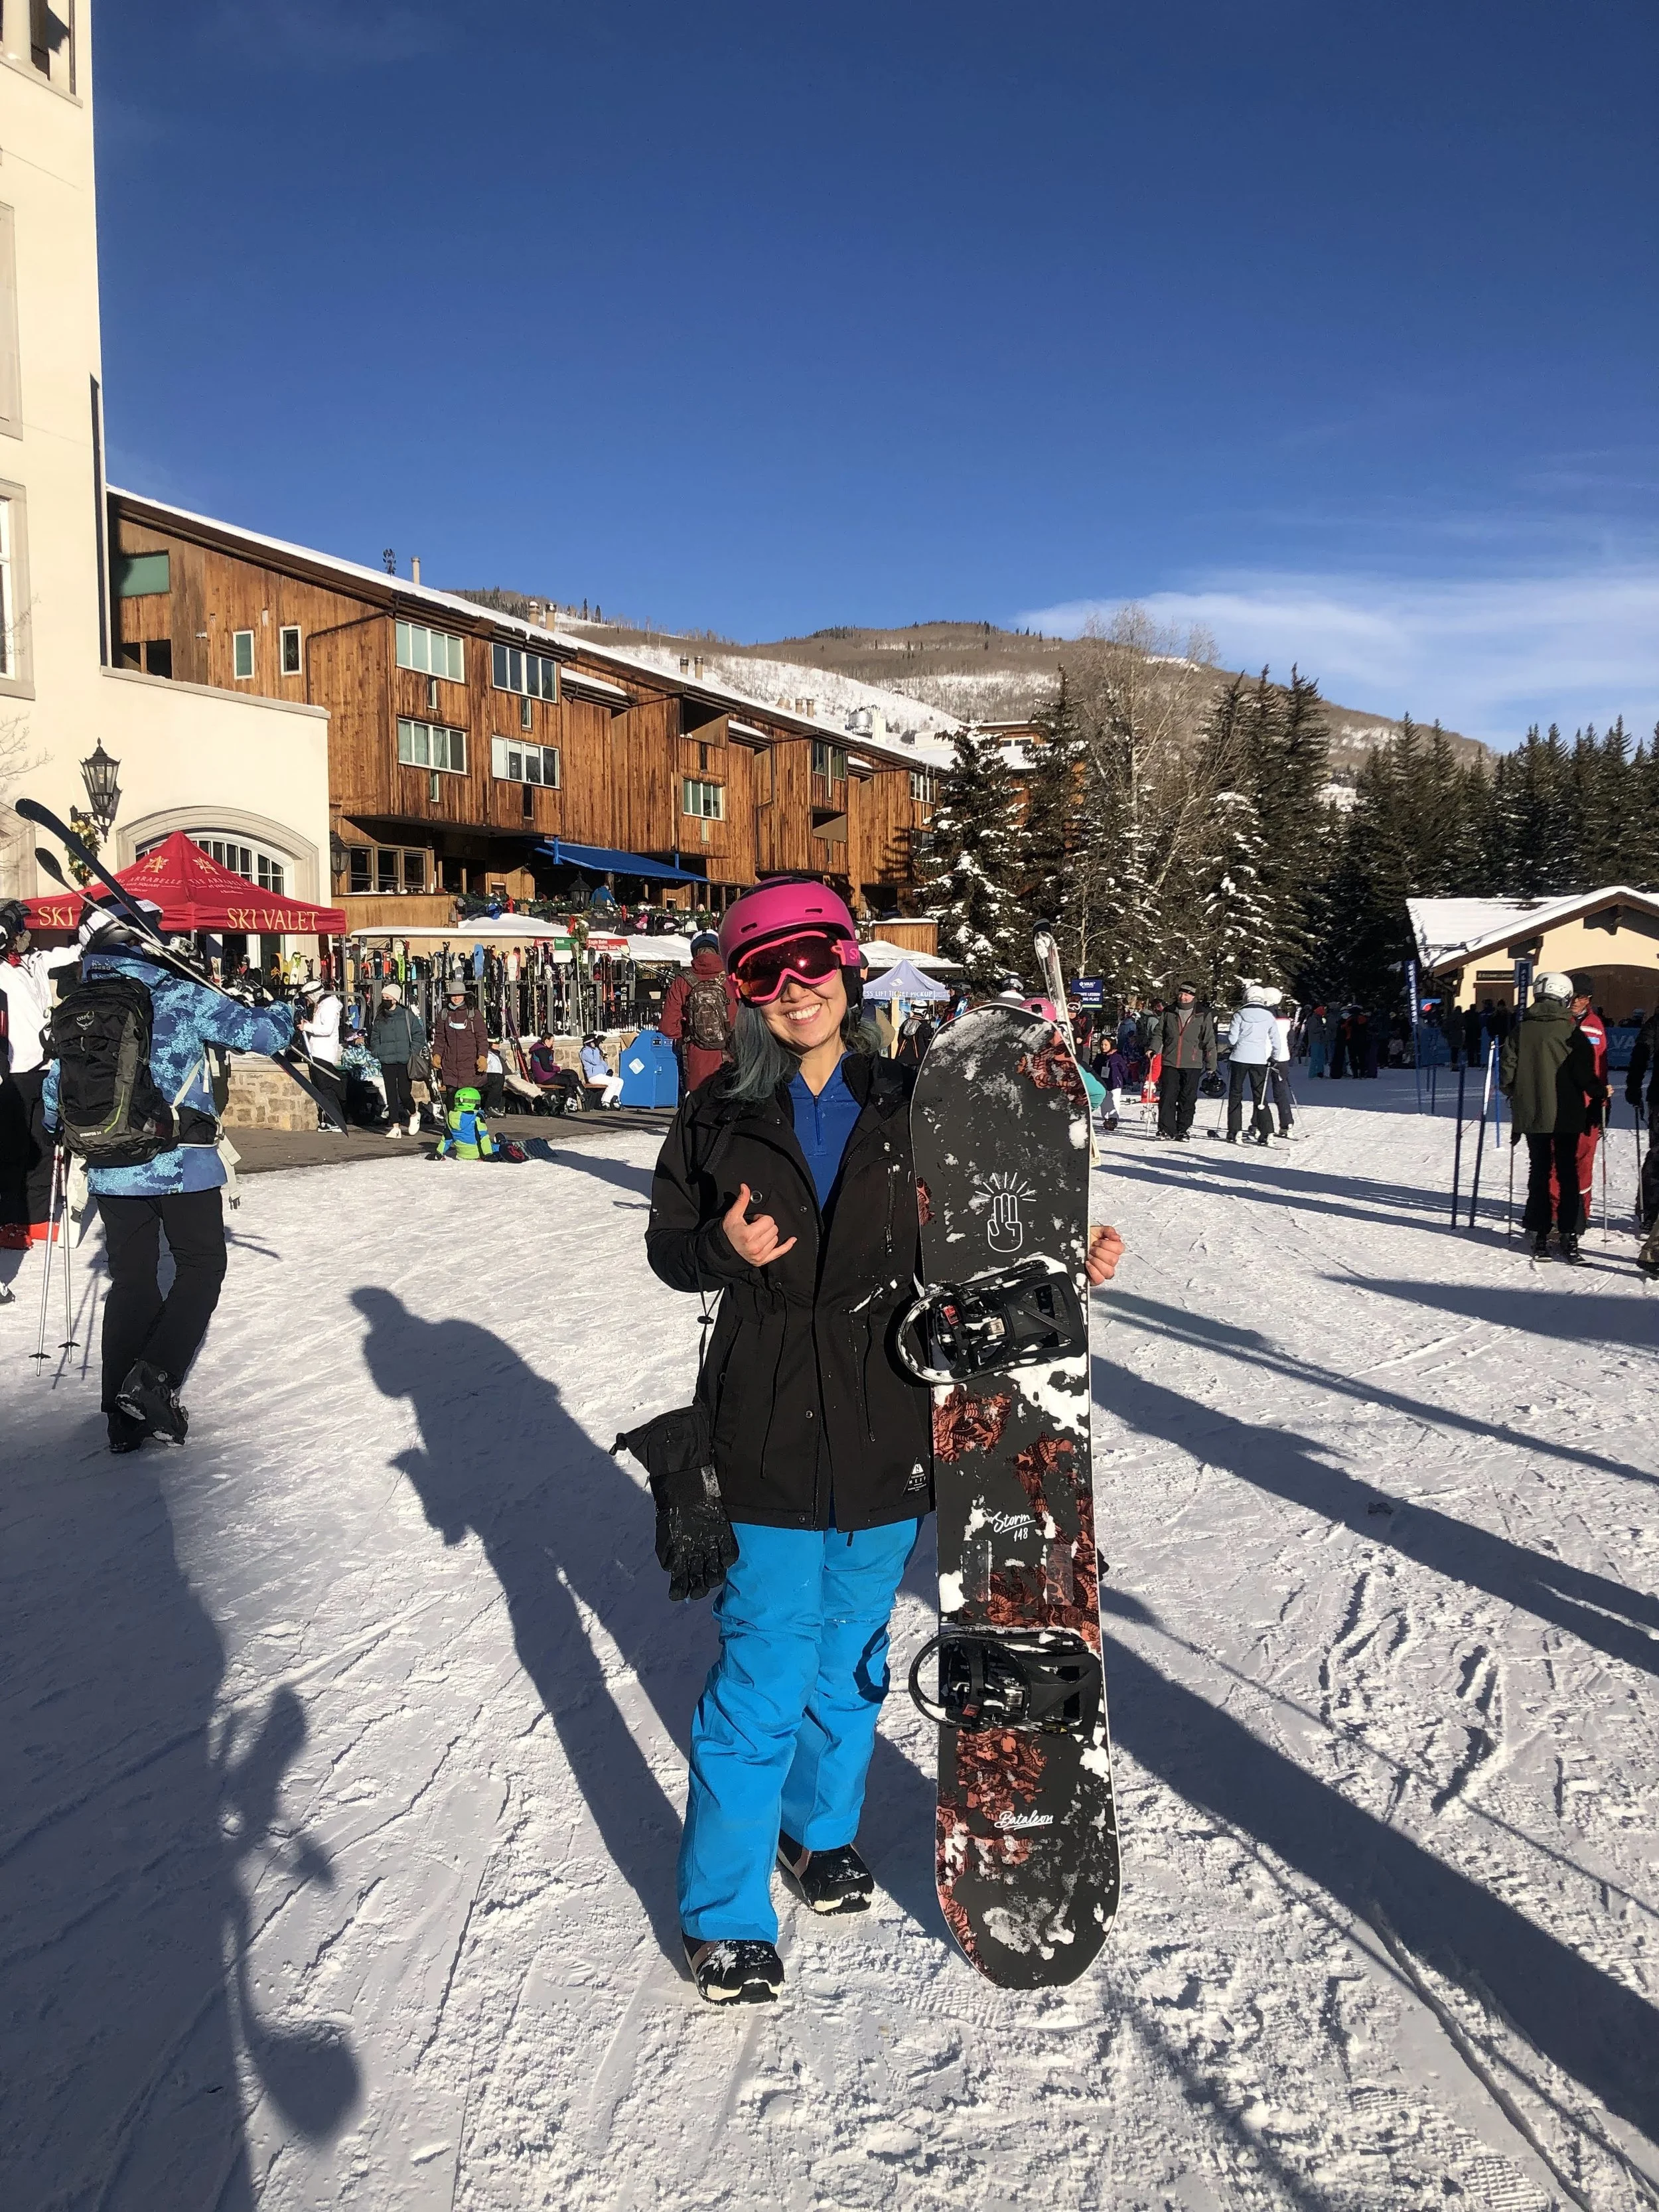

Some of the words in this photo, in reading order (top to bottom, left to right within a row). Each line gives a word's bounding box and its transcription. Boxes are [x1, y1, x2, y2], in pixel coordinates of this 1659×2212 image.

[131, 875, 183, 885] ARRABELLE
[38, 906, 74, 926] SKI
[226, 907, 258, 930] SKI
[261, 909, 320, 931] VALET
[991, 1511, 1031, 1533] Storm
[1013, 1527, 1029, 1542] 148
[994, 1809, 1054, 1830] Bataleon
